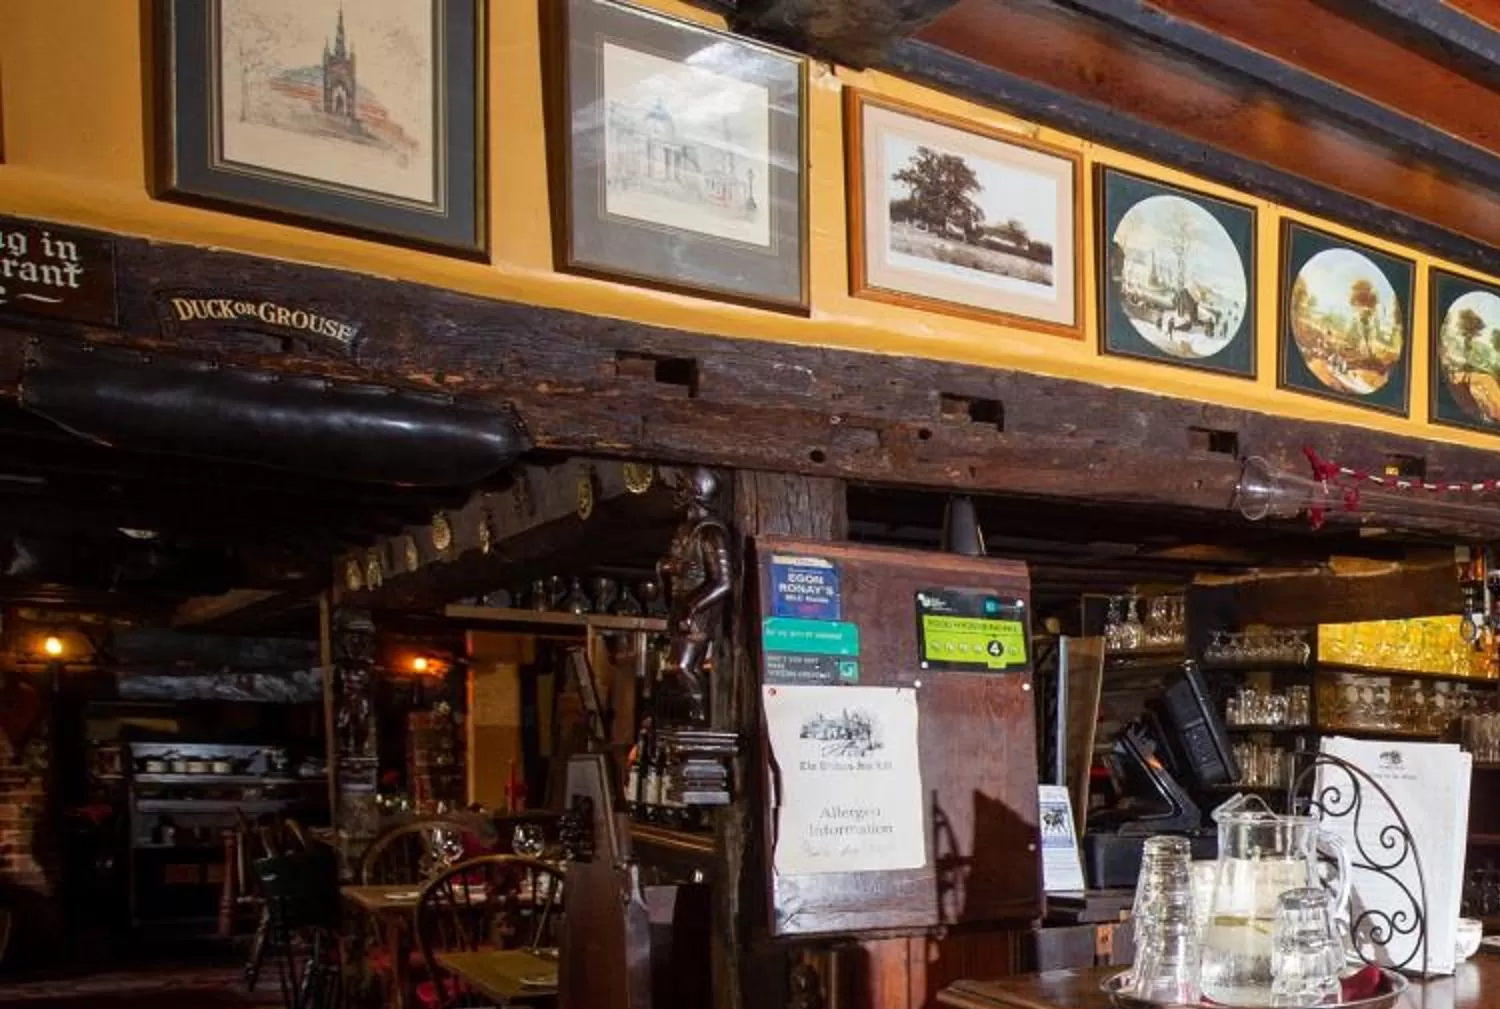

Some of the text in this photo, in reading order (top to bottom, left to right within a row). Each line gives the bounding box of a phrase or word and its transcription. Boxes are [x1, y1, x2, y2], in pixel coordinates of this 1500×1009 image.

[41, 232, 78, 260] in
[172, 298, 359, 343] DUCK OR GROUSE
[989, 642, 1001, 655] 4
[808, 823, 894, 838] Information
